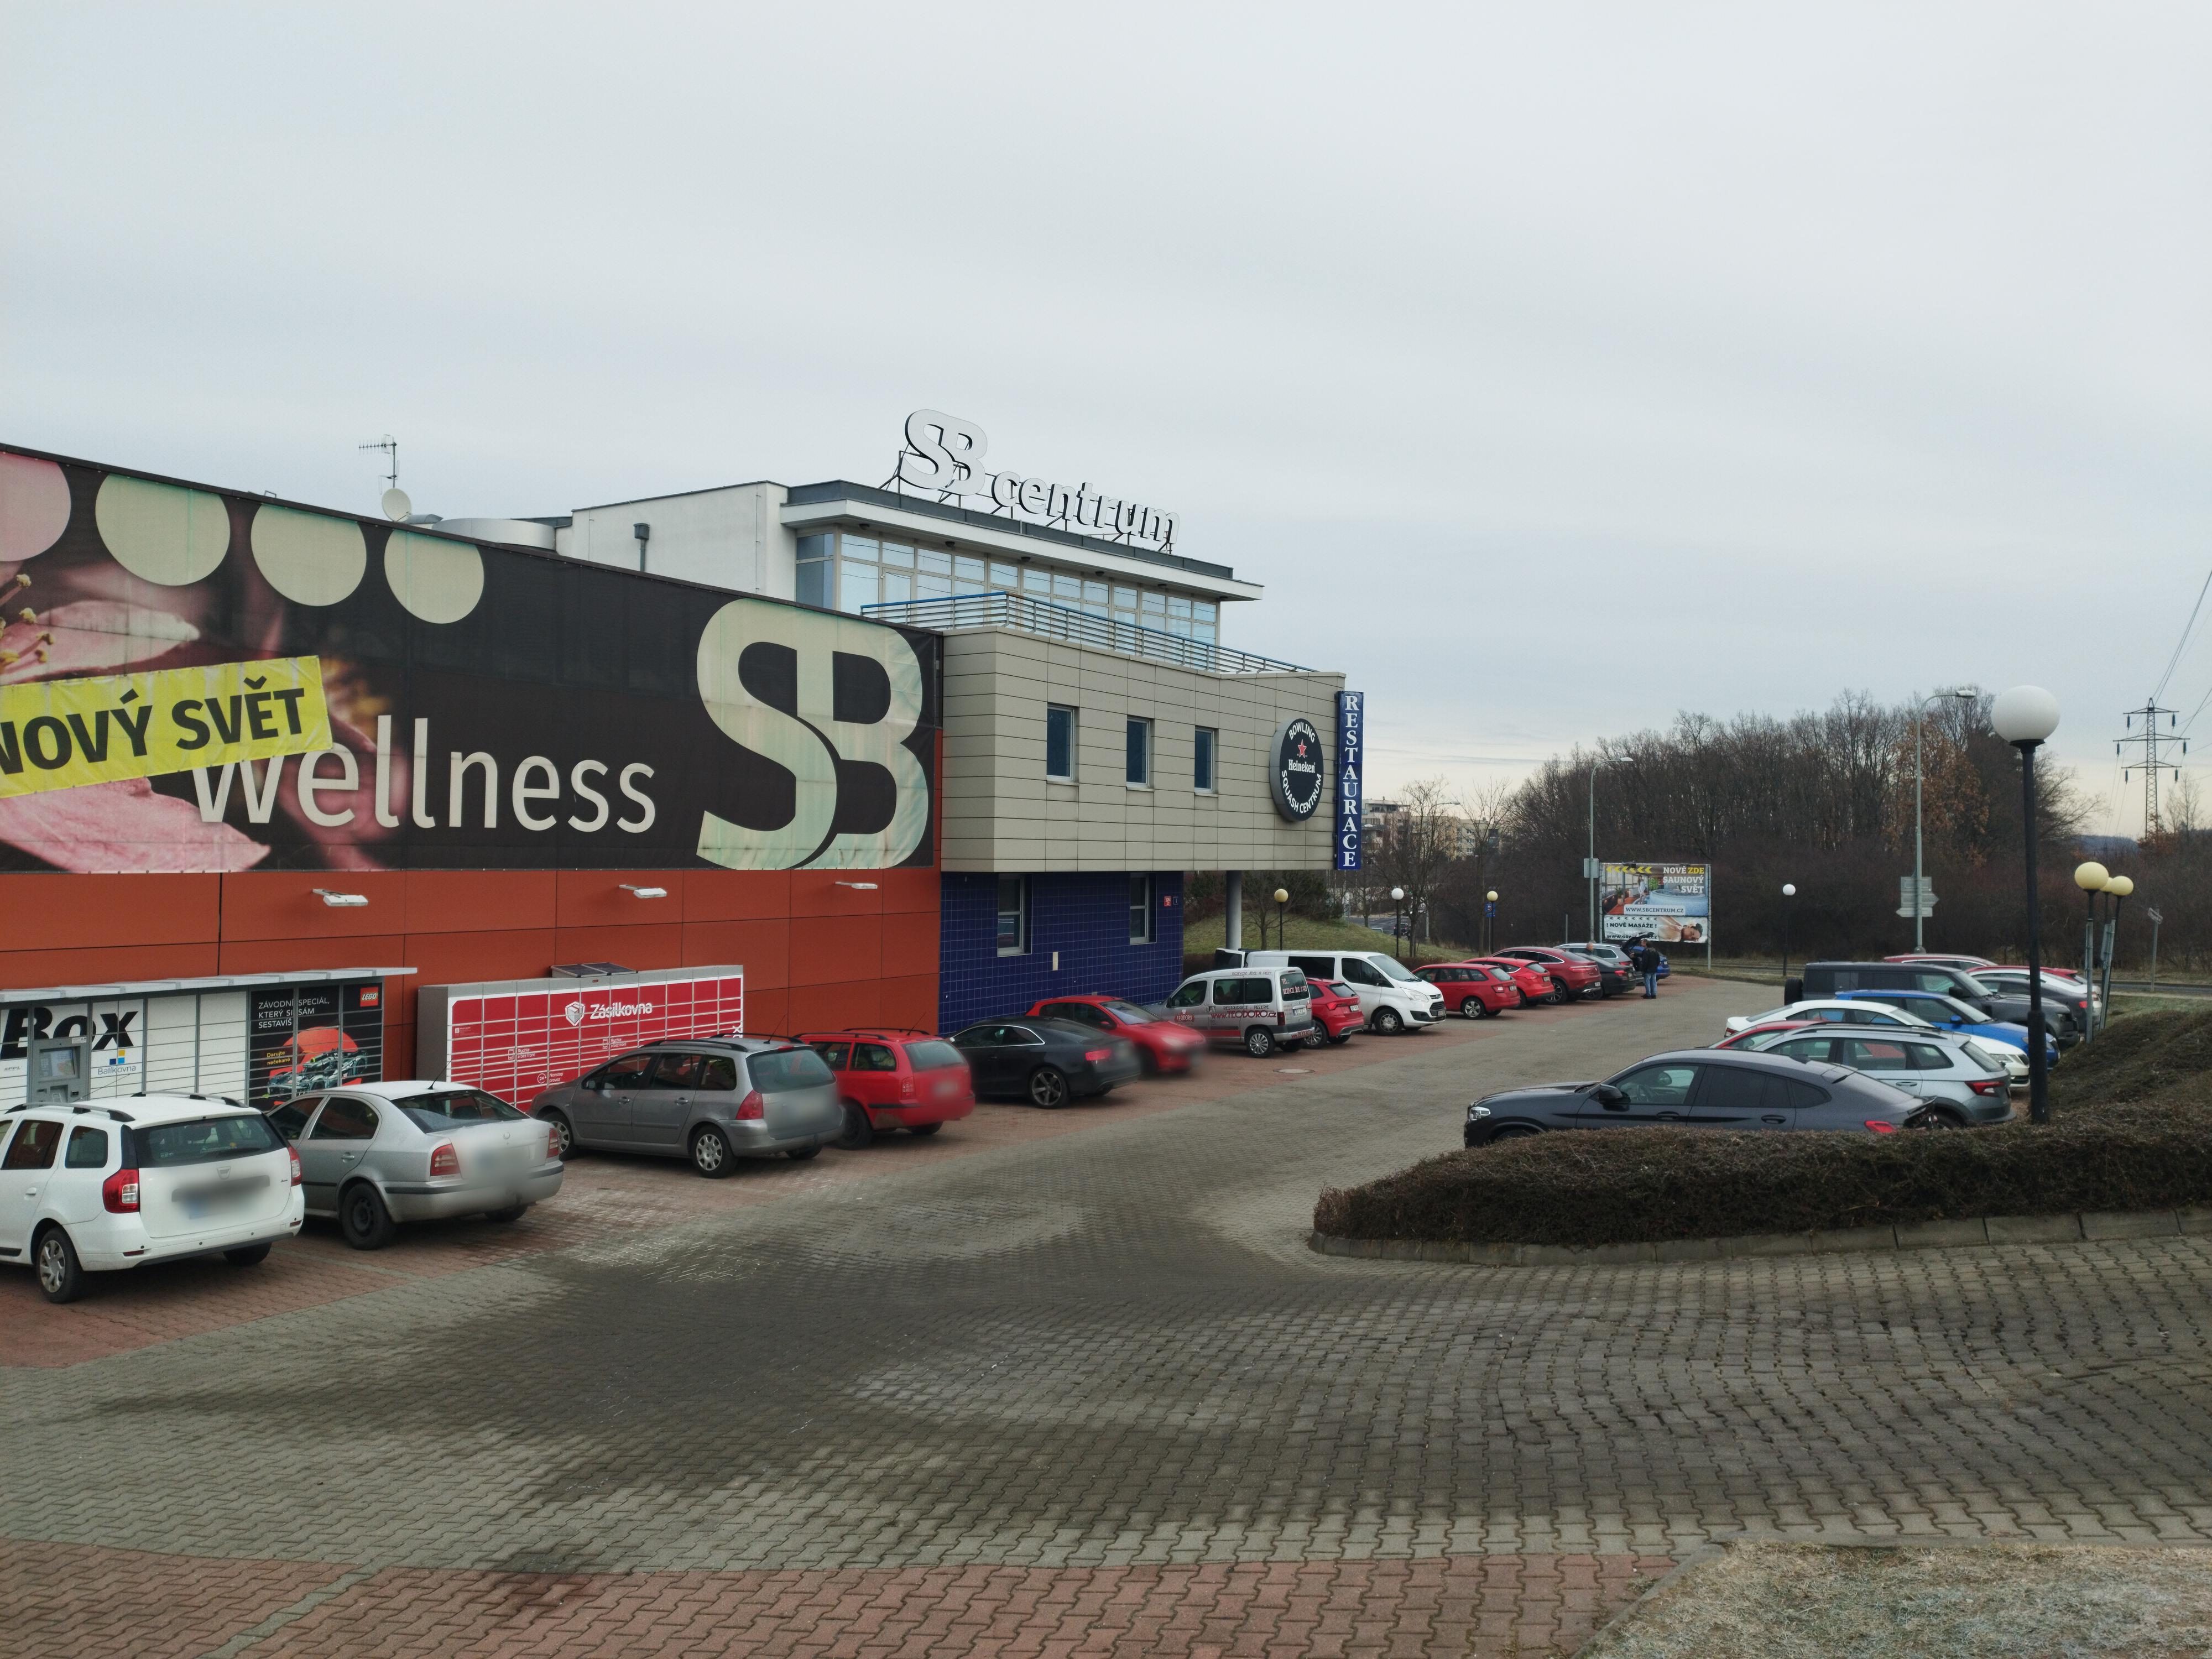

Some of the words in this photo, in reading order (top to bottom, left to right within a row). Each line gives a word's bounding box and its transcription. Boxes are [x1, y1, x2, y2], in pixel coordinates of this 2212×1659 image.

[900, 409, 988, 495] SB
[992, 471, 1180, 544] centrum
[171, 676, 305, 750] SVĚT
[696, 598, 928, 870] SB
[1289, 722, 1315, 743] BOWLING
[1288, 759, 1315, 773] Heineken
[1342, 695, 1359, 867] RESTAURACE
[1282, 770, 1299, 812] SQUASH
[1300, 774, 1322, 813] CENTRUM
[1663, 865, 1687, 874] NOVĚ
[1663, 875, 1704, 884] SAUNOVÝ
[1681, 885, 1704, 893] SVĚT
[362, 992, 378, 1001] LEGO
[258, 998, 294, 1009] ZÁVODNÍ
[299, 997, 330, 1006] SPECIÁL,
[258, 1010, 283, 1019] KTERÝ
[299, 1008, 314, 1016] SÁM
[589, 1002, 652, 1020] Zásilkovna
[258, 1019, 292, 1029] SESTAVÍŠ
[267, 1057, 290, 1066] nečekané
[98, 1065, 136, 1075] Balíkovna
